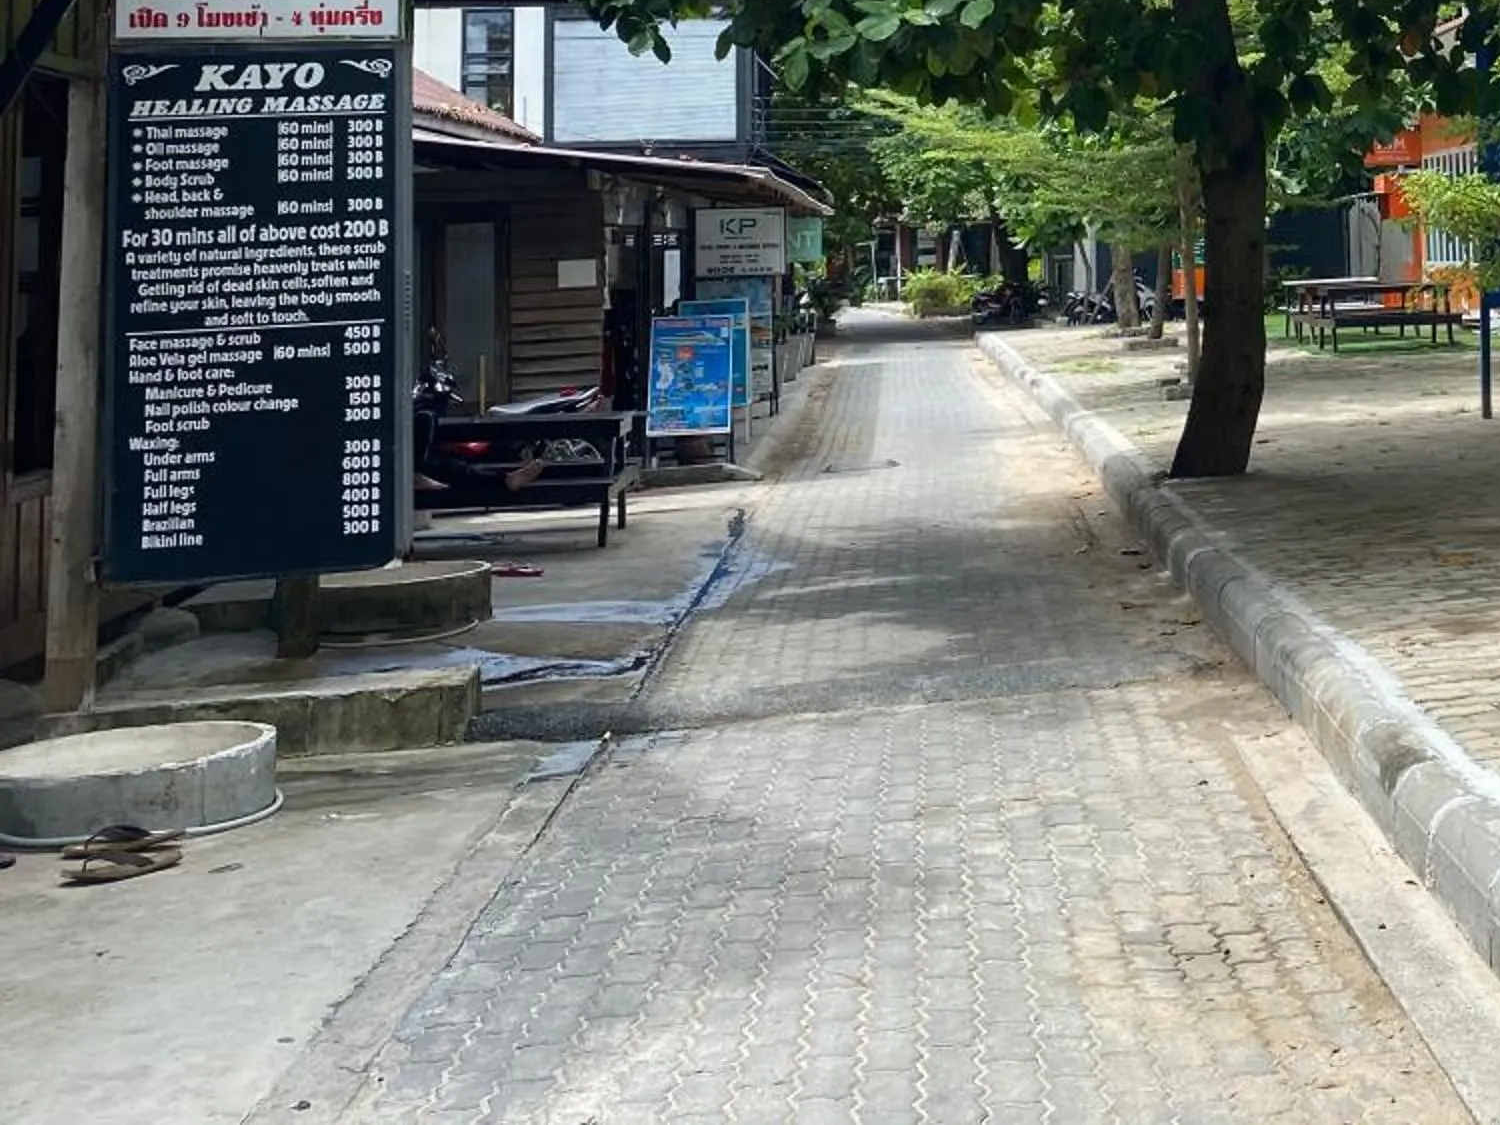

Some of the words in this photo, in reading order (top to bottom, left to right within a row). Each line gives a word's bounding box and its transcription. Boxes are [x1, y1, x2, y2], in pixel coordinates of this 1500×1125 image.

[129, 8, 168, 28] เปิด
[291, 10, 303, 24] 4
[194, 63, 324, 91] KAYO
[130, 98, 253, 117] HEALING
[260, 94, 385, 113] MASSAGE
[146, 127, 172, 139] Thai
[174, 126, 228, 141] massage
[347, 121, 373, 133] 300
[376, 120, 383, 131] B
[347, 137, 373, 148] 300
[376, 136, 383, 147] B
[146, 143, 164, 155] Oil
[166, 143, 219, 156] massage
[146, 158, 174, 171] Foot
[176, 158, 229, 171] massage
[347, 152, 373, 164] 300
[376, 151, 383, 163] B
[347, 168, 373, 180] 500
[376, 167, 383, 178] B
[146, 176, 178, 190] Body
[180, 174, 215, 186] Scrub
[182, 190, 211, 201] back
[213, 189, 224, 200] &
[144, 206, 198, 219] shoulder
[201, 205, 254, 219] massage
[347, 200, 373, 211] 300
[376, 199, 383, 210] B
[122, 230, 148, 248] For
[152, 229, 172, 246] 30
[176, 227, 214, 245] mins
[218, 225, 236, 243] all
[239, 225, 256, 242] of
[260, 224, 306, 241] above
[310, 222, 340, 239] cost
[344, 220, 376, 237] 200
[379, 219, 388, 236] B
[720, 219, 756, 234] KP
[126, 253, 135, 265] A
[138, 251, 181, 265] variety
[184, 249, 197, 262] of
[200, 248, 241, 261] natural
[319, 243, 351, 255] these
[354, 241, 386, 254] scrub
[132, 267, 198, 280] treatments
[202, 264, 251, 279] promise
[254, 261, 308, 275] heavenly
[311, 259, 344, 271] treats
[348, 257, 380, 269] while
[138, 283, 184, 297] Getting
[188, 281, 204, 294] rid
[207, 281, 220, 293] of
[222, 279, 253, 292] dead
[256, 279, 278, 290] skin
[351, 274, 374, 286] and
[130, 300, 168, 313] refine
[170, 300, 199, 313] your
[232, 294, 276, 309] leaving
[279, 293, 298, 306] the
[302, 292, 332, 306] body
[336, 289, 380, 302] smooth
[205, 314, 228, 326] and
[230, 312, 254, 324] soft
[257, 312, 269, 323] to
[344, 327, 369, 339] 450
[373, 326, 380, 338] B
[129, 339, 157, 351] Face
[160, 337, 214, 349] massage
[216, 334, 226, 346] &
[228, 332, 261, 345] scrub
[343, 342, 369, 355] 500
[373, 342, 380, 354] B
[129, 355, 156, 367] Aloe
[188, 351, 206, 367] gel
[209, 349, 262, 363] massage
[129, 371, 162, 384] Hand
[165, 370, 174, 381] &
[178, 368, 202, 380] foot
[345, 377, 370, 388] 300
[145, 387, 204, 400] Manicure
[207, 384, 216, 396] &
[219, 383, 272, 396] Pedicure
[349, 393, 370, 405] 150
[145, 405, 170, 418] Nail
[172, 402, 210, 418] polish
[213, 400, 251, 413] colour
[254, 397, 298, 411] change
[345, 408, 370, 421] 300
[145, 420, 174, 433] Foot
[176, 418, 210, 431] scrub
[344, 440, 370, 453] 300
[144, 453, 182, 465] Under
[184, 452, 215, 463] arms
[342, 457, 369, 469] 600
[144, 469, 168, 483] Full
[170, 469, 200, 481] arms
[342, 473, 369, 485] 800
[144, 485, 166, 499] Full
[169, 485, 195, 499] legs
[342, 488, 369, 501] 400
[143, 502, 168, 515] Half
[170, 501, 196, 515] legs
[343, 505, 369, 517] 500
[143, 518, 195, 531] Brazilian
[343, 521, 369, 534] 300
[142, 534, 176, 549] Bikini
[180, 533, 203, 546] line
